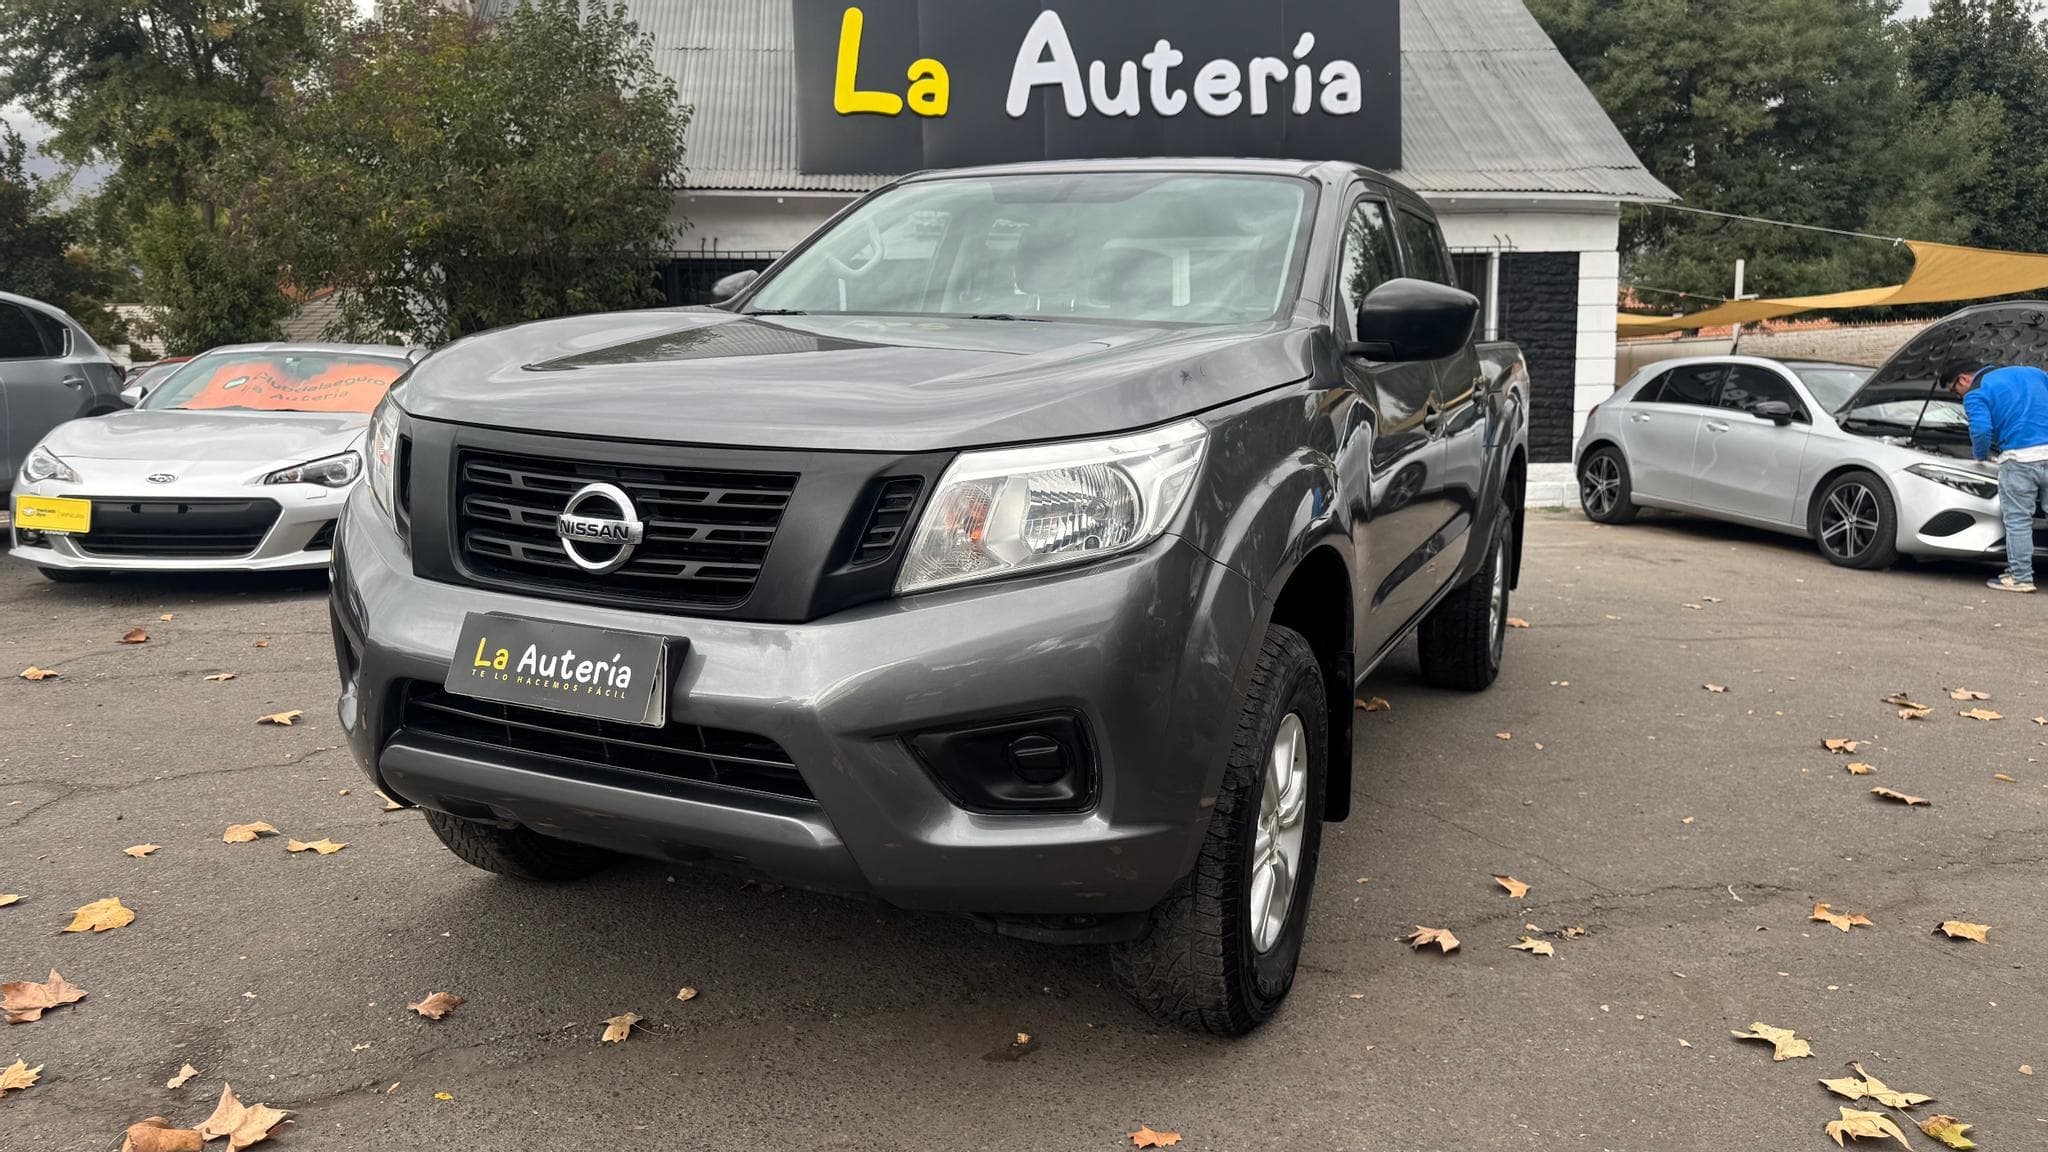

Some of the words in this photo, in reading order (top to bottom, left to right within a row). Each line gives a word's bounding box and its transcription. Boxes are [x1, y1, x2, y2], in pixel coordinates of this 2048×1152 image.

[834, 7, 950, 117] La
[1006, 9, 1362, 118] Autería
[559, 519, 630, 541] NISSAN
[471, 668, 486, 678] TE
[494, 672, 508, 681] LO
[516, 675, 579, 692] HACEMOS
[587, 686, 625, 699] FÁCIL
[474, 637, 509, 670] La
[516, 643, 633, 689] Autería
